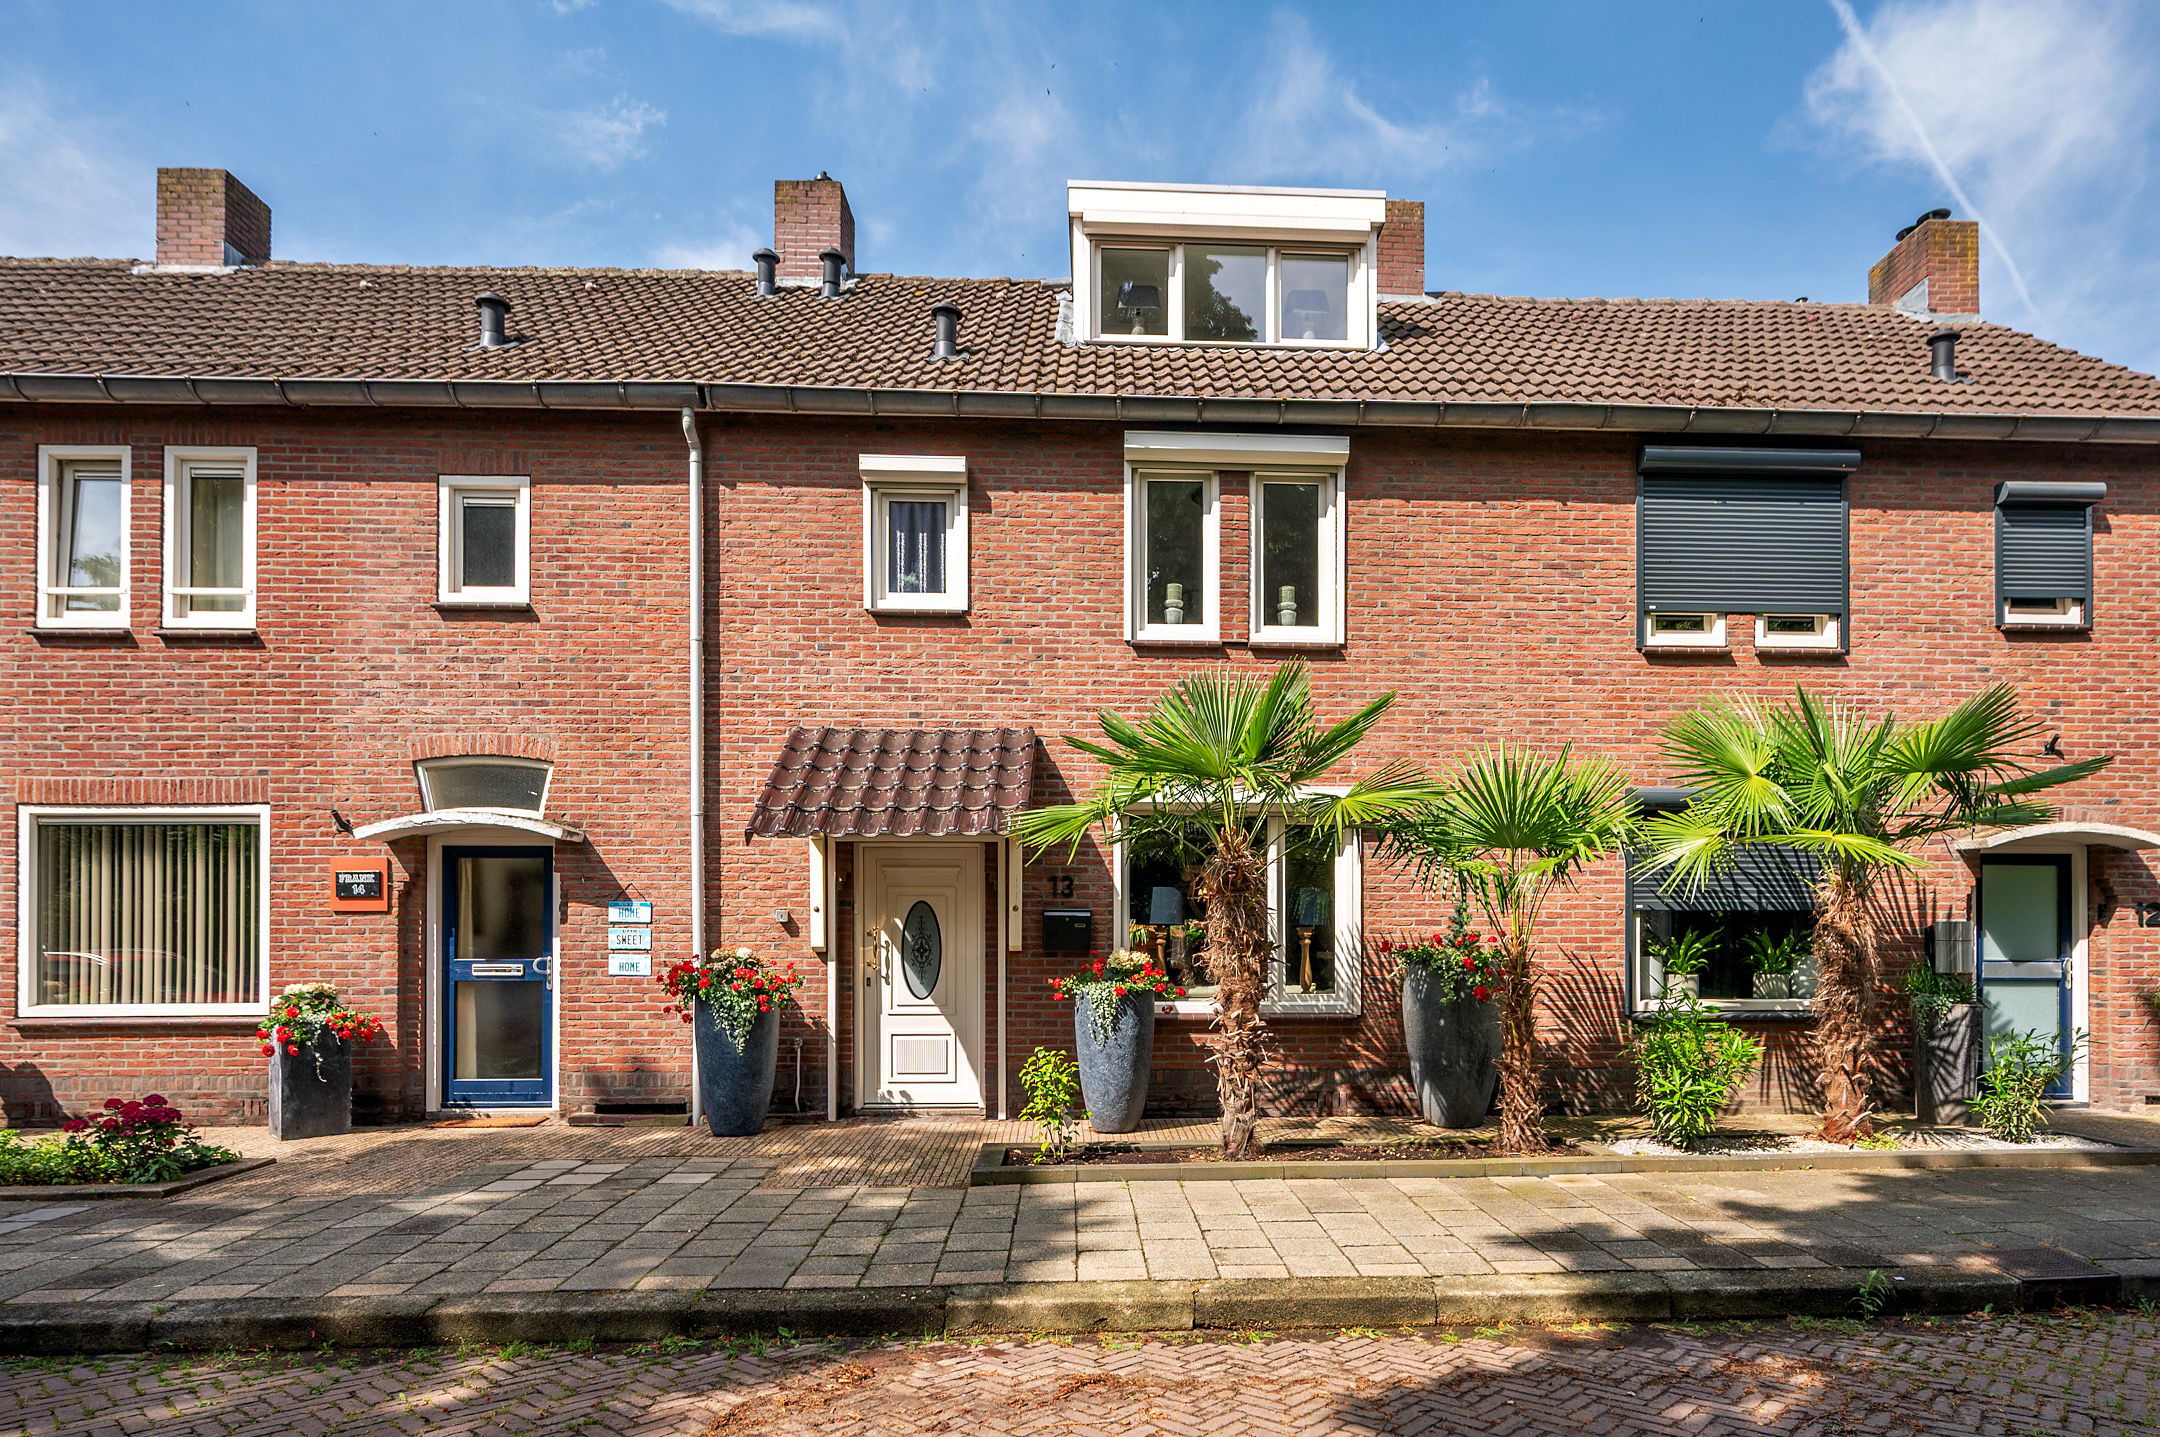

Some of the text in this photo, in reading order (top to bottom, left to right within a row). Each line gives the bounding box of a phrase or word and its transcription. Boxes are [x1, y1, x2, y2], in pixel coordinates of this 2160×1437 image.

[352, 884, 366, 895] 14
[1047, 875, 1074, 898] 13
[618, 907, 640, 918] HOME
[2135, 903, 2160, 928] 12
[616, 934, 642, 945] SWEET
[618, 961, 640, 972] HOME
